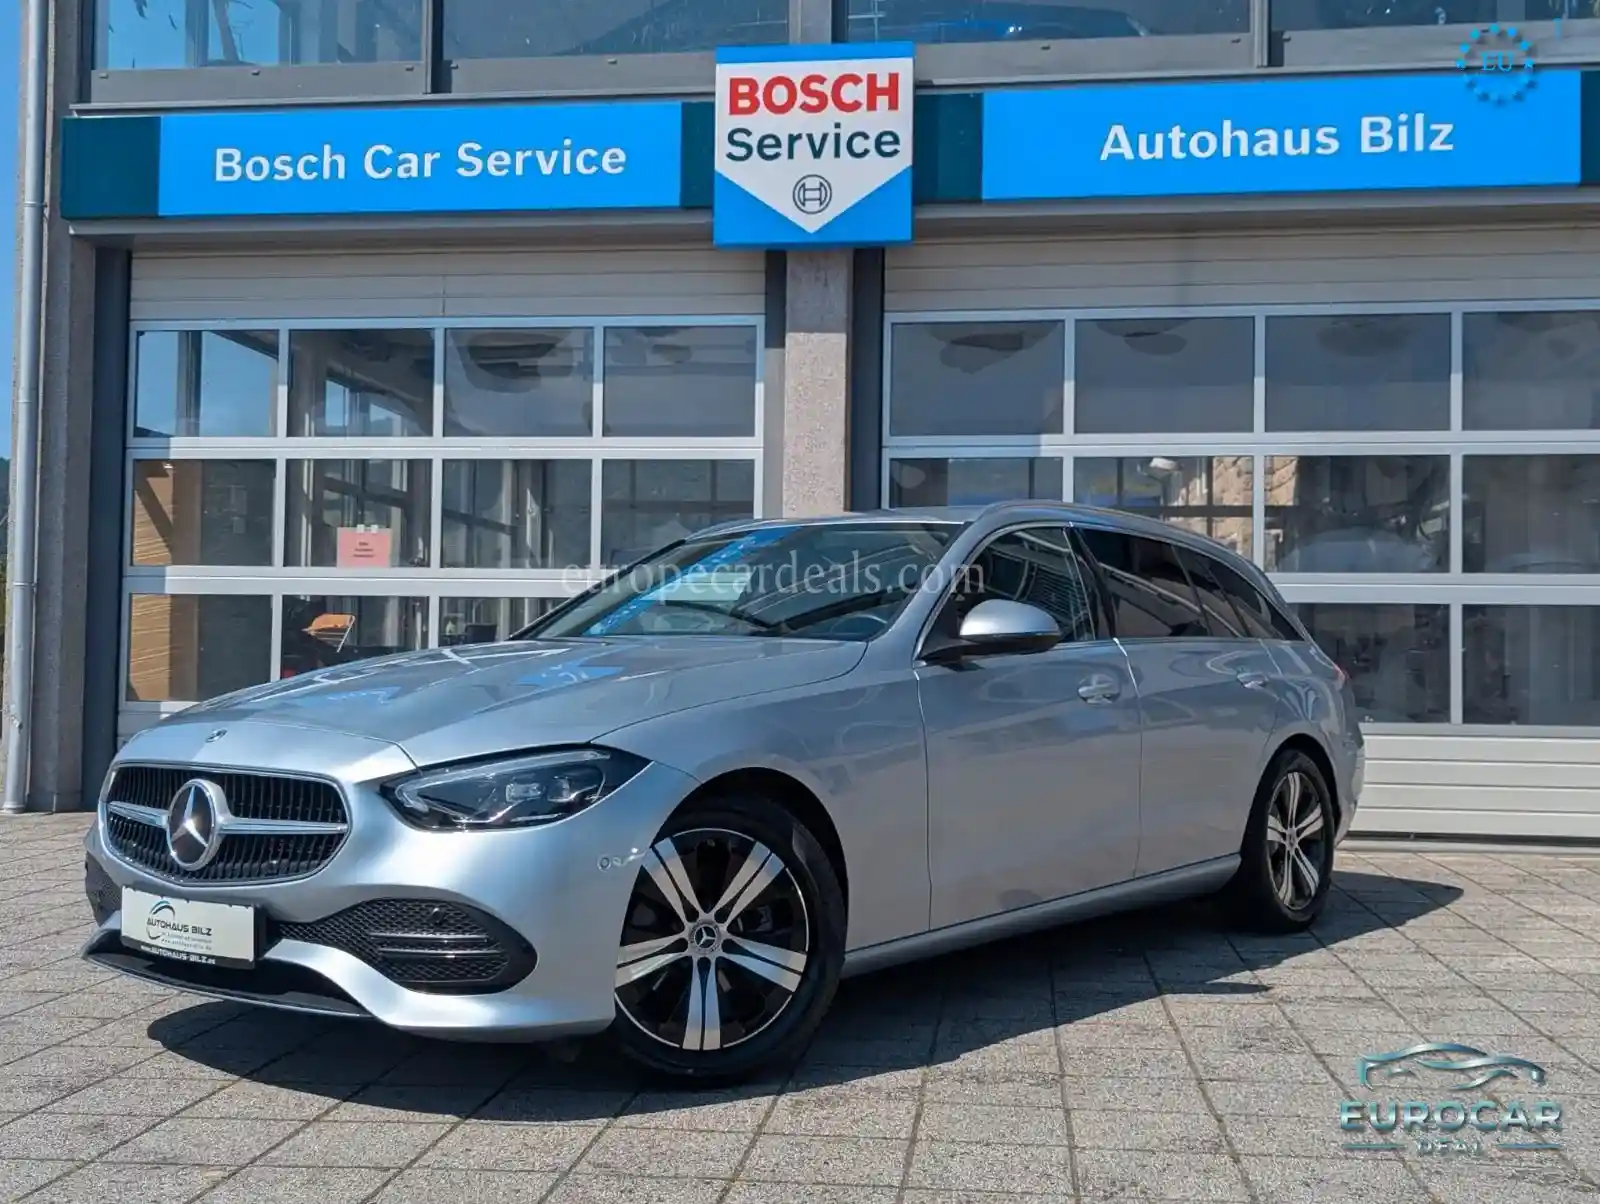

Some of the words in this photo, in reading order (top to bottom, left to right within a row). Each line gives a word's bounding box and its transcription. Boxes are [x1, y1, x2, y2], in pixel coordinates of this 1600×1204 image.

[729, 72, 900, 116] BOSCH
[725, 122, 901, 162] Service
[1100, 119, 1341, 161] Autohaus
[1360, 112, 1454, 154] Bilz
[214, 144, 346, 182] Bosch
[363, 143, 441, 180] Car
[455, 137, 628, 178] Service
[146, 917, 190, 933] AUTOHAUS
[191, 925, 213, 937] BILZ
